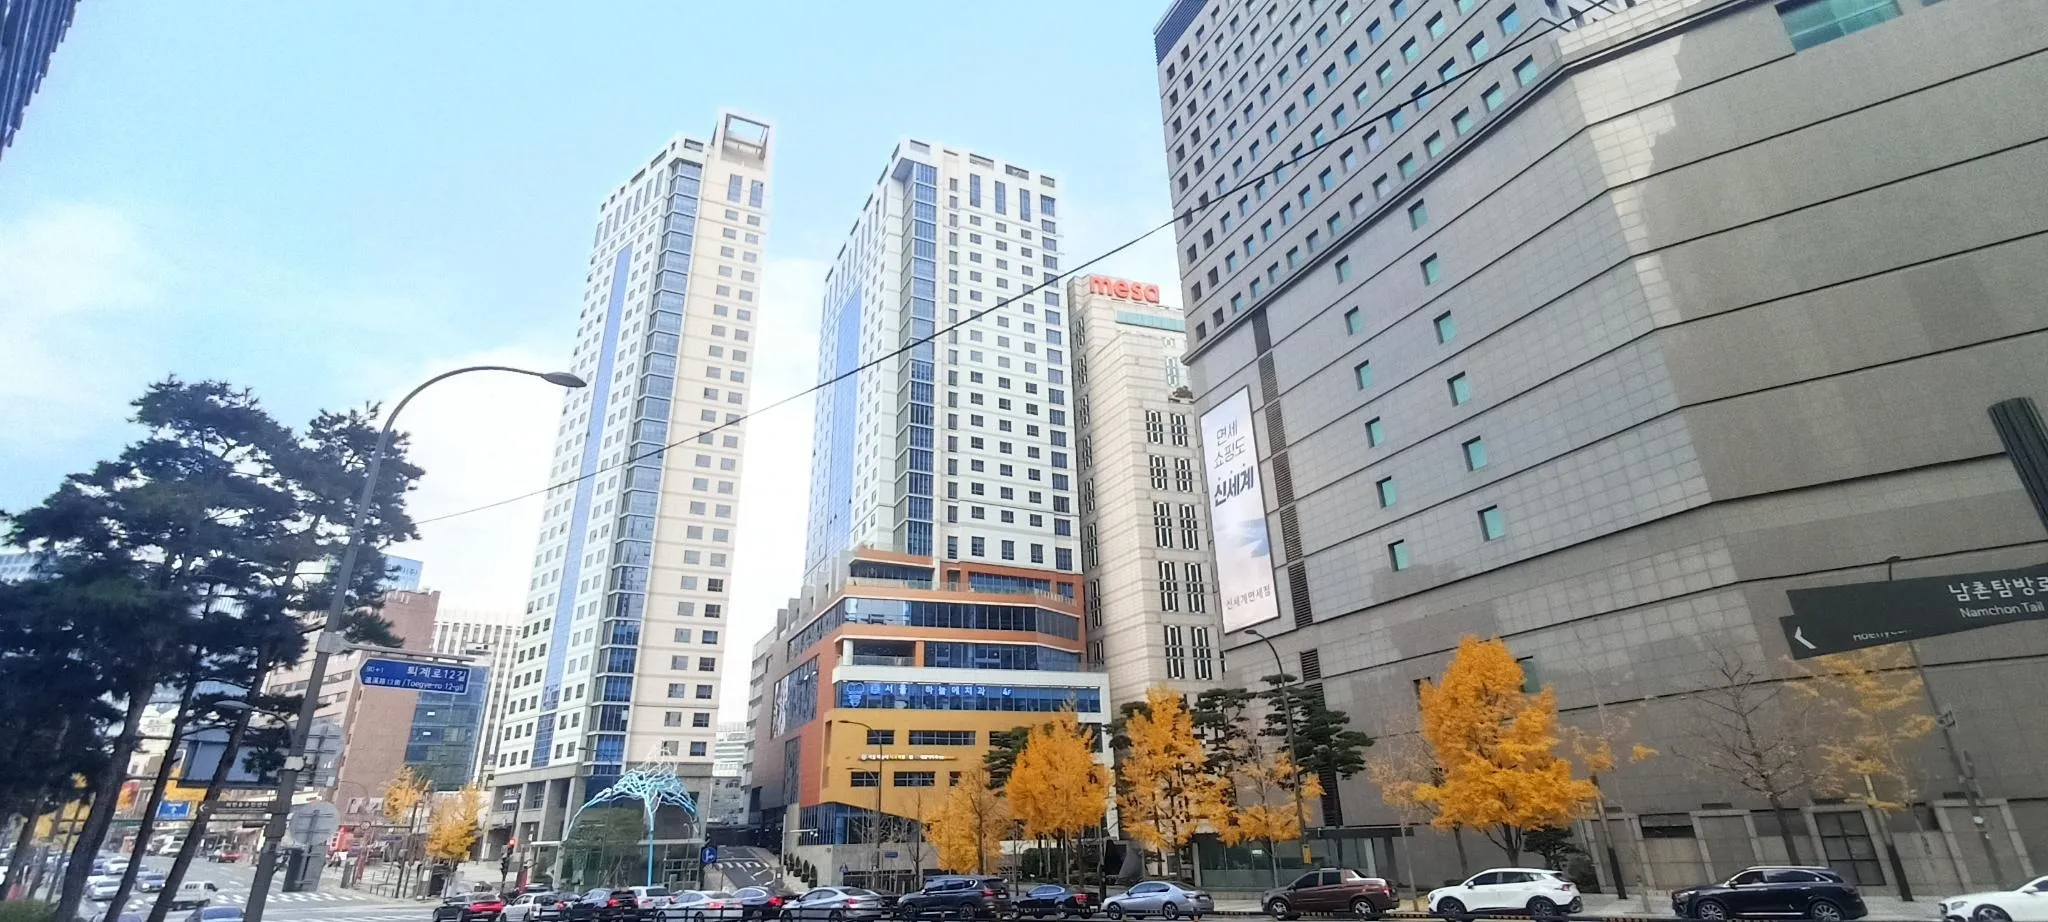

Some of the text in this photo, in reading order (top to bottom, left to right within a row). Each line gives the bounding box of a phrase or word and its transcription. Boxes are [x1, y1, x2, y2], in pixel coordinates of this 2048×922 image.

[1090, 276, 1159, 304] mesa
[1216, 418, 1237, 446] 면세
[1214, 436, 1246, 469] 쇼핑도
[1214, 465, 1254, 507] 신세계
[1959, 601, 2045, 618] Namchon Tail
[407, 665, 467, 682] 퇴계로12길
[884, 684, 908, 696] 서울
